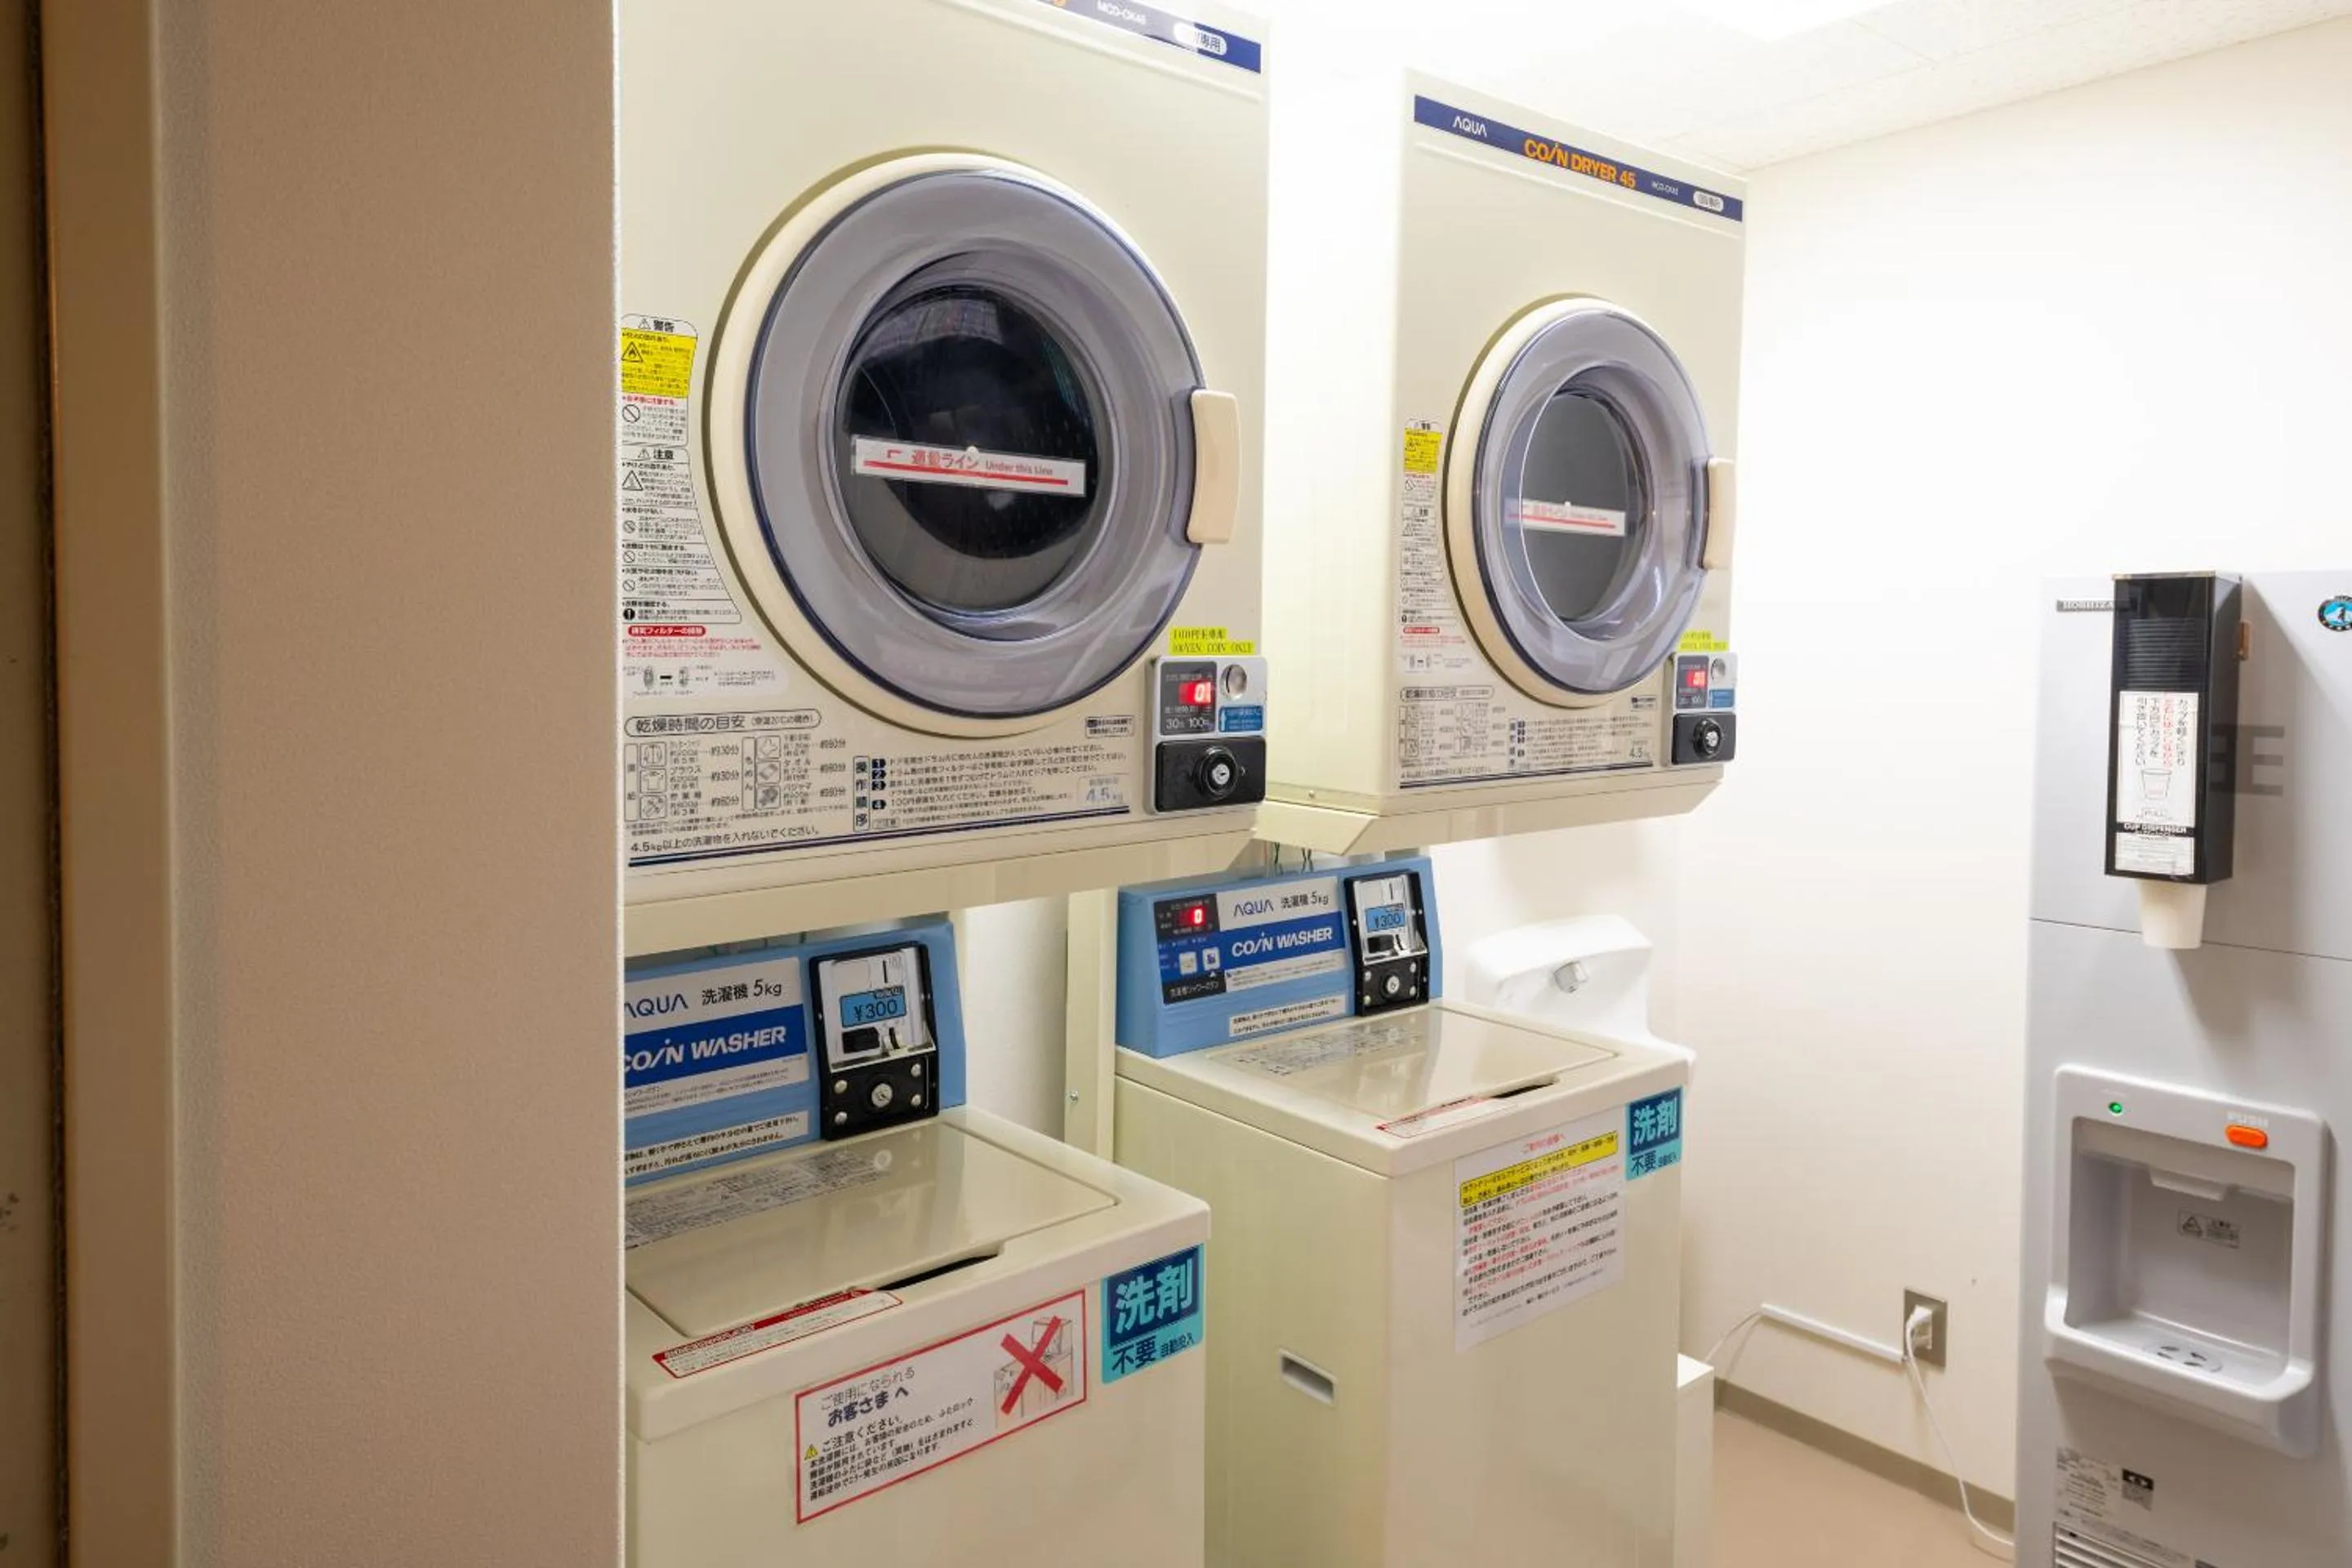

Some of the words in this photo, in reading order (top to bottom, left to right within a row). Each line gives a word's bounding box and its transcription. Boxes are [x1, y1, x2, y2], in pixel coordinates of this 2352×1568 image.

[1454, 115, 1487, 137] AQUA
[1524, 138, 1568, 166] COIN
[1570, 154, 1618, 183] DRYER
[1619, 170, 1637, 189] 45
[654, 449, 674, 460] 注意
[986, 460, 1013, 472] Under
[1015, 463, 1032, 474] this
[636, 715, 746, 733] 乾燥時間の目安
[1233, 899, 1275, 918] AQUA
[1280, 894, 1308, 910] 洗濯機
[1310, 891, 1330, 906] 5kg
[1232, 931, 1275, 958] COIN
[1277, 925, 1333, 951] WASHER
[701, 984, 749, 1005] 洗濯機
[752, 978, 783, 999] 5kg
[853, 998, 898, 1022] ¥300
[693, 1025, 787, 1060] WASHER
[1633, 1095, 1678, 1147] 洗剤
[1631, 1149, 1656, 1177] 不要
[1116, 1258, 1193, 1334] 洗剤
[1111, 1334, 1157, 1374] 不要
[821, 1365, 915, 1411] ご使用になられる
[826, 1385, 909, 1428] お客さまへ
[822, 1416, 903, 1453] ご注意ください。
